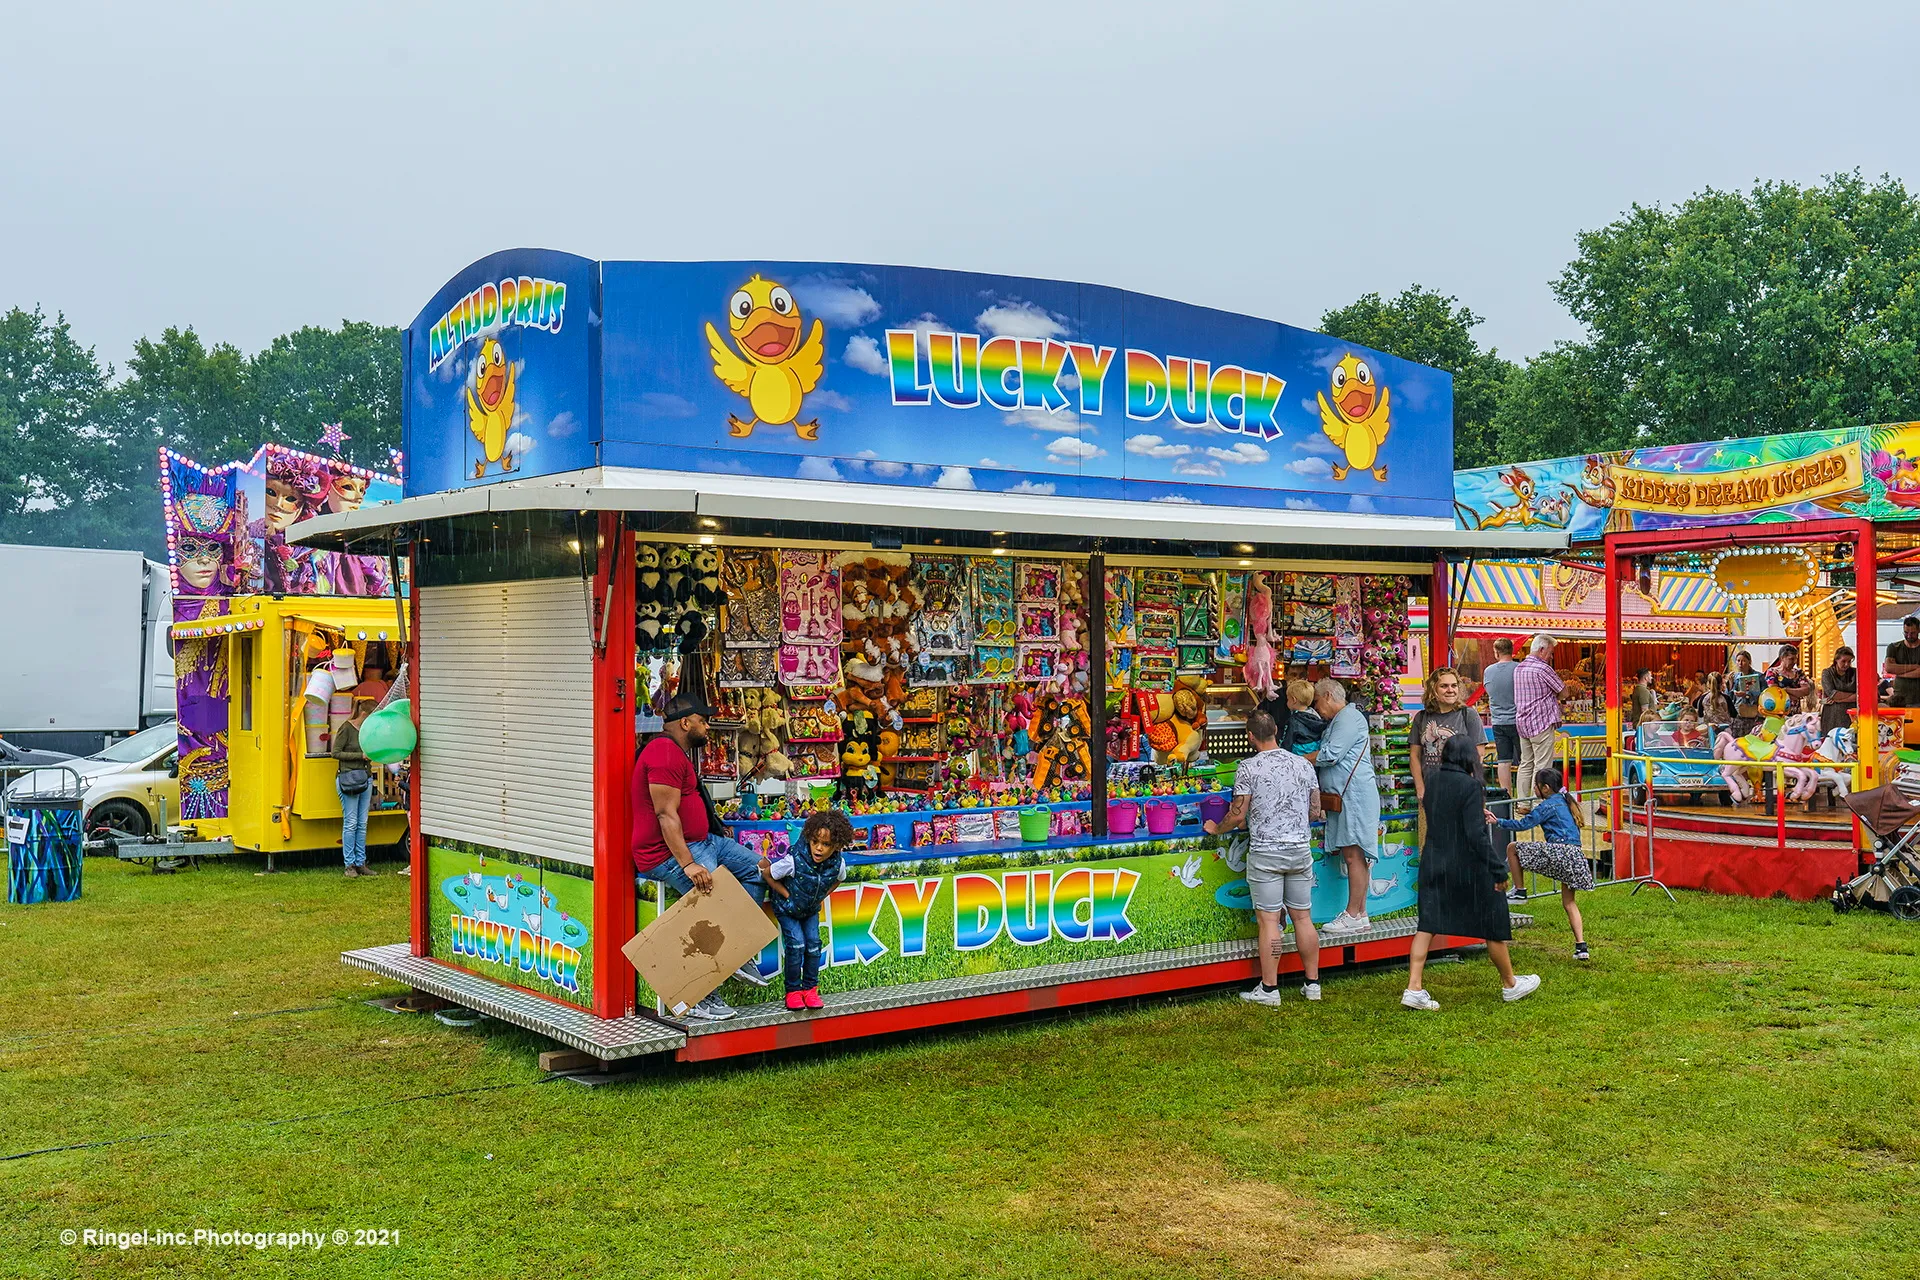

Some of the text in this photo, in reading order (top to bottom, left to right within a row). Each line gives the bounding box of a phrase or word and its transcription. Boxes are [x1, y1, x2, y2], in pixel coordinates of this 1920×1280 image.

[429, 276, 567, 374] ALTIJD PRIJS
[885, 329, 1287, 443] LUCKY DUCK
[1620, 455, 1847, 507] KIDDYS DREAM WORLD
[953, 867, 1141, 951] DUCK
[451, 914, 582, 994] LUCKY DUCK
